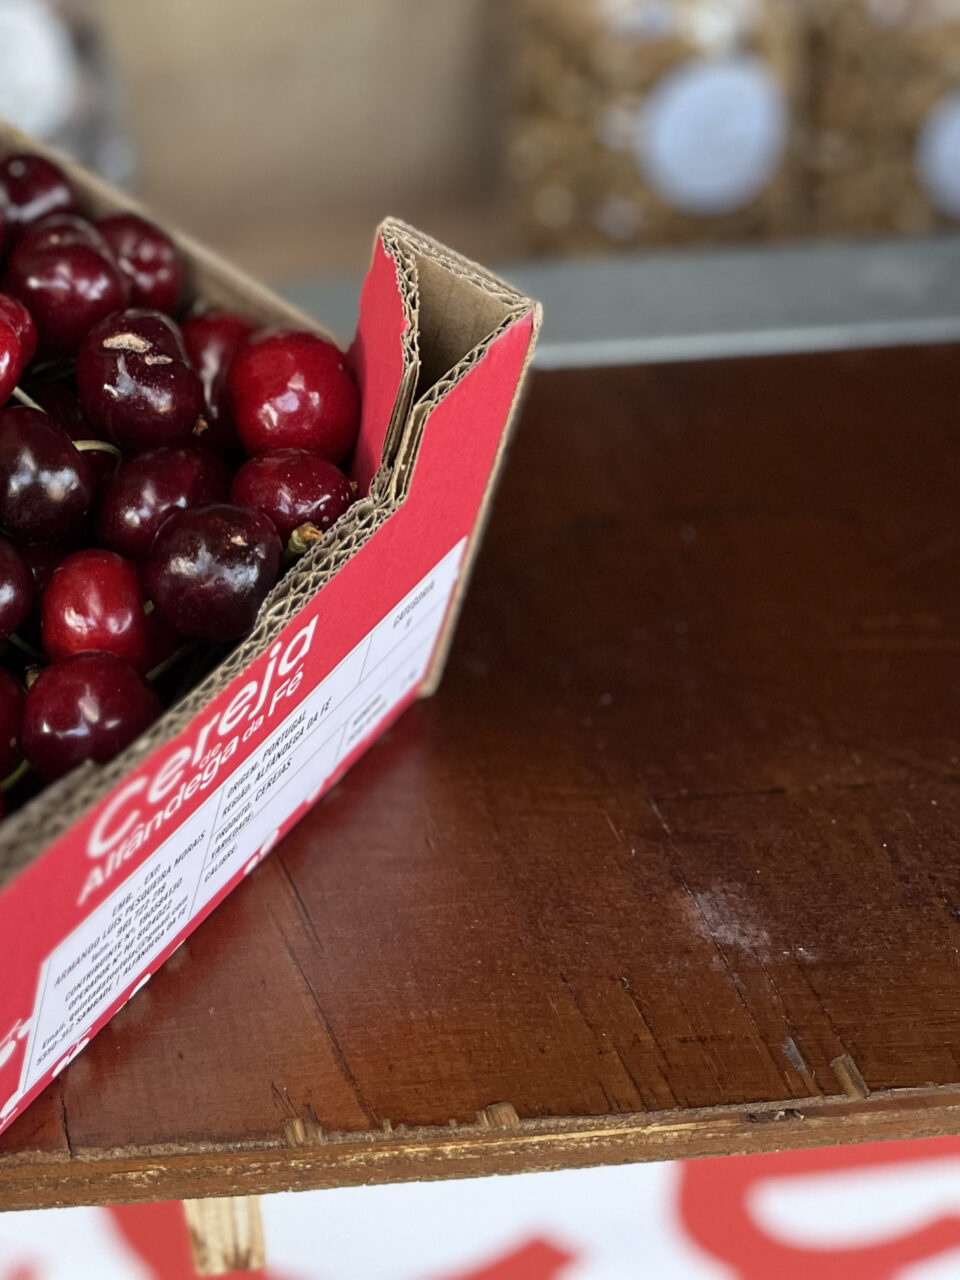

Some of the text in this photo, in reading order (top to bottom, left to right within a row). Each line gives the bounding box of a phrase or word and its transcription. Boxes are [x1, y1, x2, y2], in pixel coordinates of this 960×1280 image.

[87, 614, 319, 859] Cereja
[262, 710, 307, 763] PORTUGAL
[306, 711, 319, 730] DA
[77, 663, 304, 906] Alfândega da Fé
[199, 742, 221, 769] de
[255, 757, 292, 802] CEREJAS
[54, 936, 100, 988] ARMANDO
[125, 865, 171, 918] PESQUEIRA
[173, 829, 206, 868] MORAIS
[65, 938, 124, 1002] CONTRIBUINTE
[68, 963, 111, 1011] OPERADOR
[76, 982, 113, 1026] SAMBADE
[166, 917, 176, 931] DA
